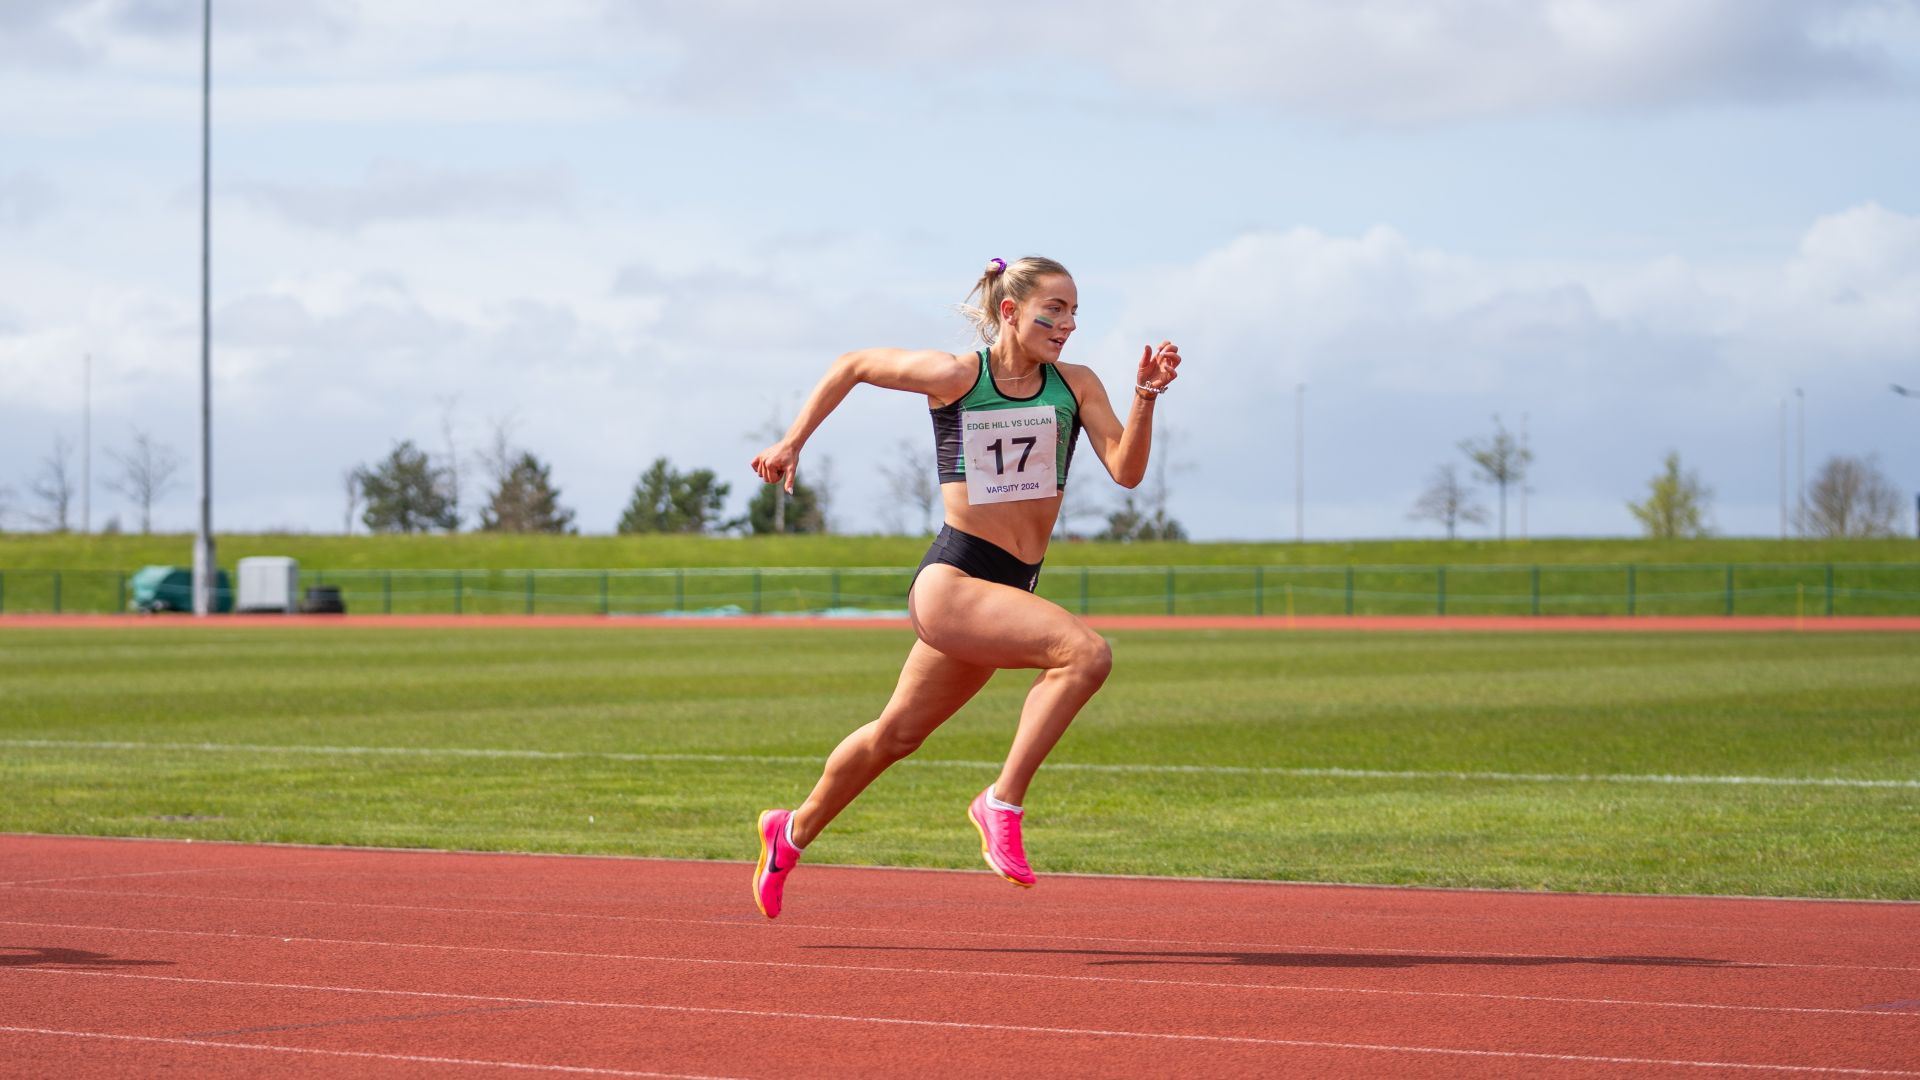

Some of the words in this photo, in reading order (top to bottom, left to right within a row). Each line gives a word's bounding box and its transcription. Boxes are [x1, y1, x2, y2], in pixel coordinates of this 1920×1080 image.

[967, 422, 990, 430] EDGE
[992, 421, 1009, 429] HILL
[1024, 418, 1052, 426] UCLAN
[987, 436, 1036, 475] 17
[986, 484, 1019, 493] VARSITY
[1021, 482, 1039, 491] 2024
